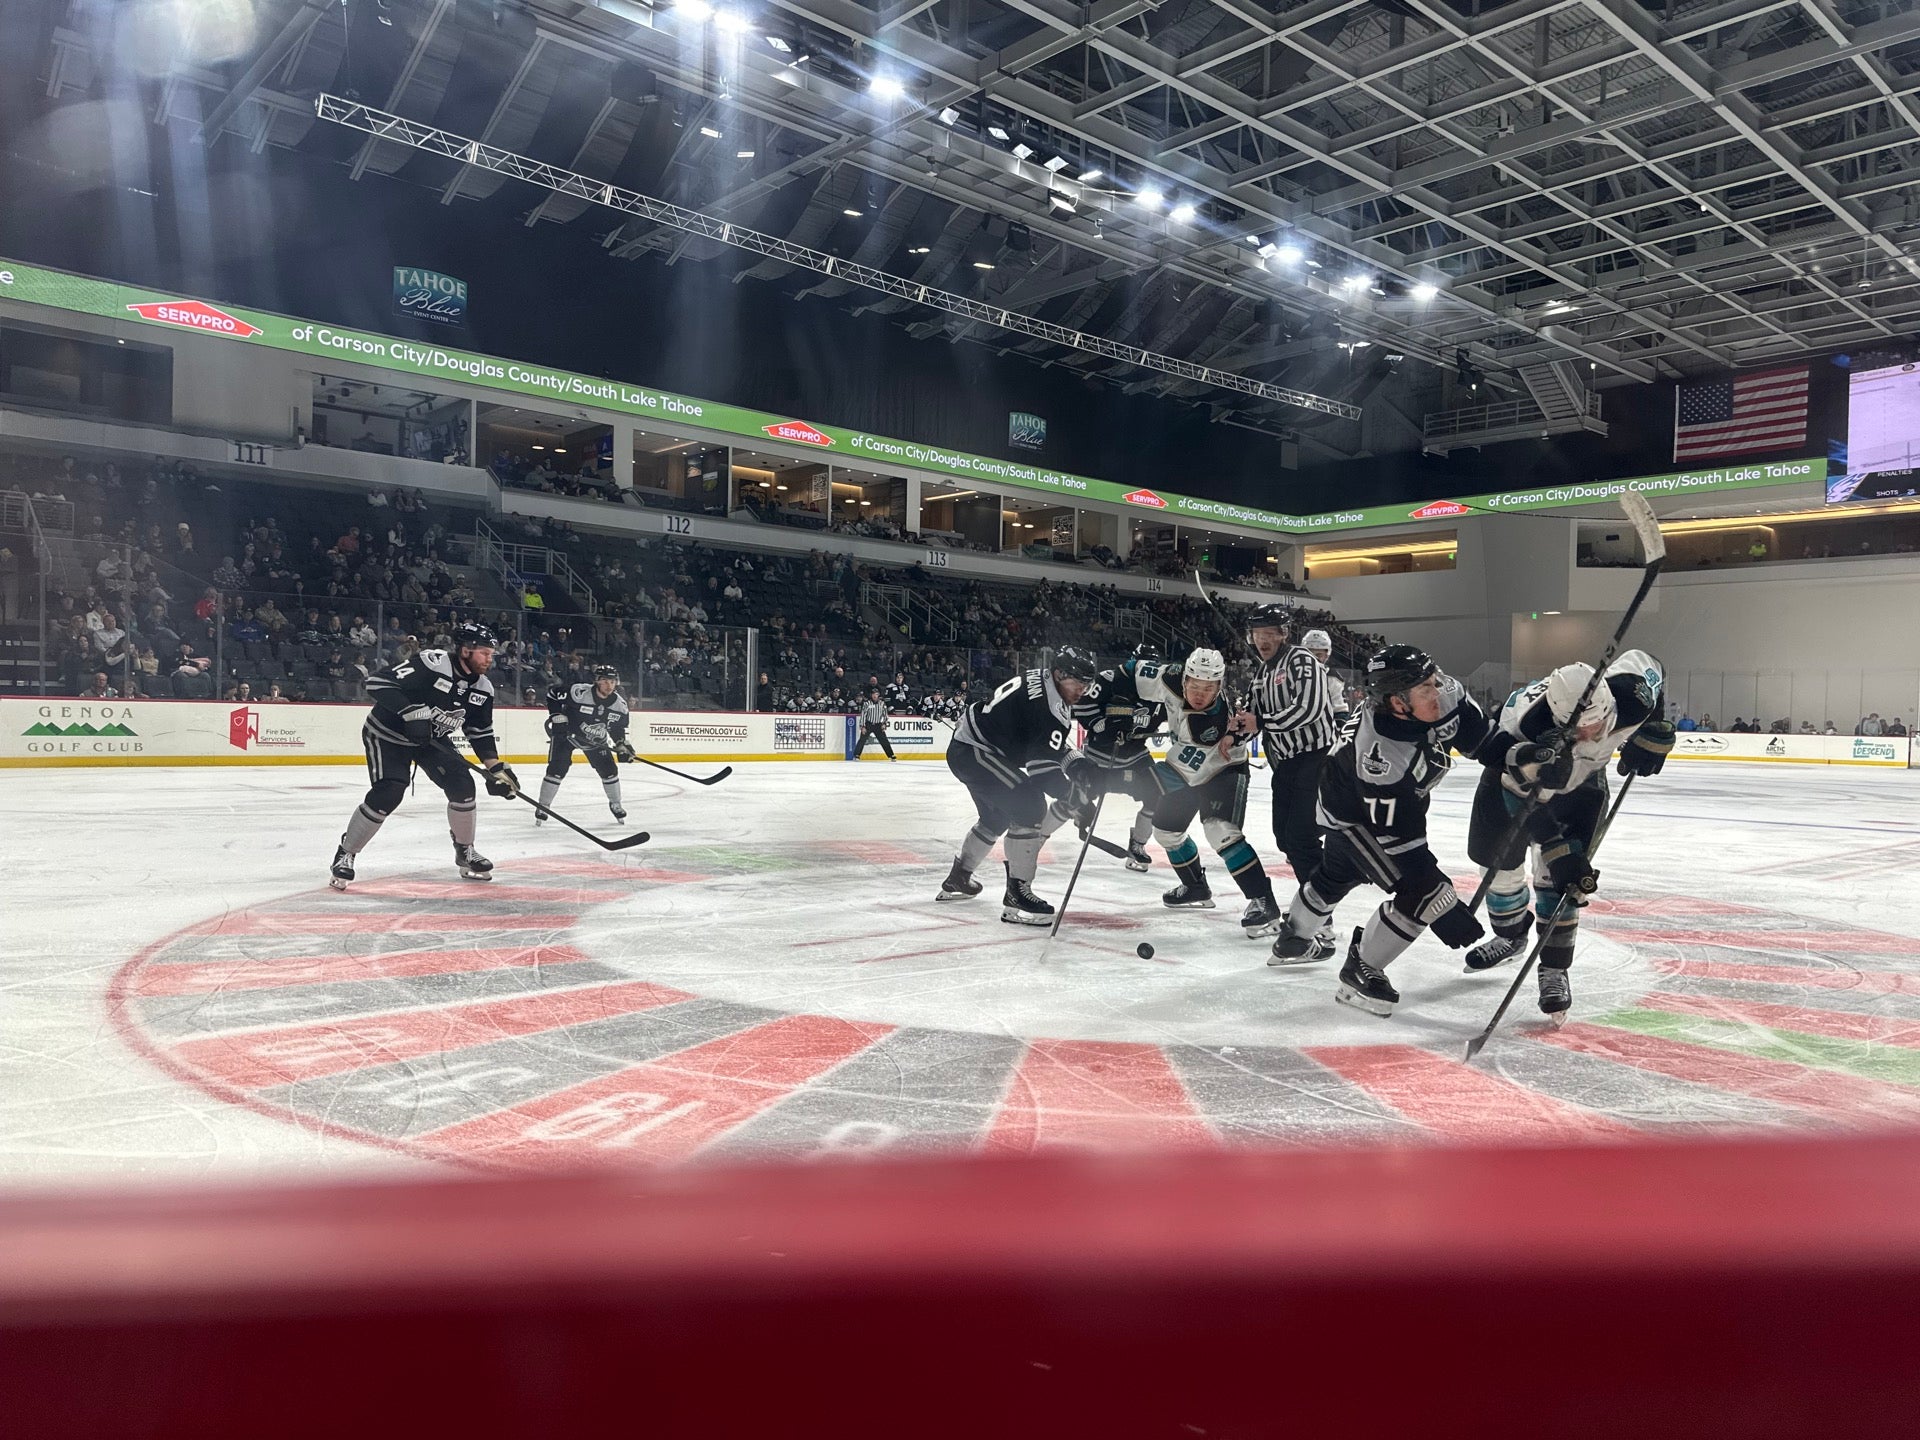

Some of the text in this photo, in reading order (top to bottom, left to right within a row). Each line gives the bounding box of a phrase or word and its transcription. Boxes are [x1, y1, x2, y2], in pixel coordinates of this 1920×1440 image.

[396, 269, 466, 300] TAHOE
[400, 288, 461, 316] Blue
[157, 307, 235, 331] SERVPRO
[413, 311, 449, 323] EVENT CENTER
[292, 326, 703, 417] of Carson City/Douglas County/South Lake Tahoe
[1012, 414, 1046, 433] TAHOE
[778, 426, 821, 442] SERVPRO
[1013, 426, 1044, 445] Blue
[235, 443, 266, 465] 111
[852, 436, 1087, 490] of Carson City/Douglas County/South Lake Tahoe
[1877, 469, 1913, 478] PENALTIES
[1488, 464, 1811, 507] of Carson City/Douglas County/South Lake Tahoe
[1876, 489, 1899, 497] SHOTS
[1132, 494, 1160, 506] SERVPRO
[1178, 498, 1187, 508] of
[1187, 499, 1212, 513] Carson
[1309, 515, 1332, 527] Lake
[1334, 512, 1364, 525] Tahoe
[1422, 505, 1459, 517] SERVPRO
[666, 515, 691, 535] 112
[929, 550, 946, 567] 113
[1148, 578, 1161, 591] 114
[391, 659, 416, 679] 14
[1295, 665, 1313, 679] 75
[38, 706, 133, 719] GENOA
[649, 726, 748, 736] THERMAL TECHNOLOGY LLC
[893, 721, 933, 731] OUTINGS
[27, 742, 144, 752] GOLF CLUB
[1049, 729, 1063, 751] 9
[1178, 745, 1207, 771] 92
[1856, 748, 1891, 756] DESCEND
[1363, 797, 1397, 827] 77
